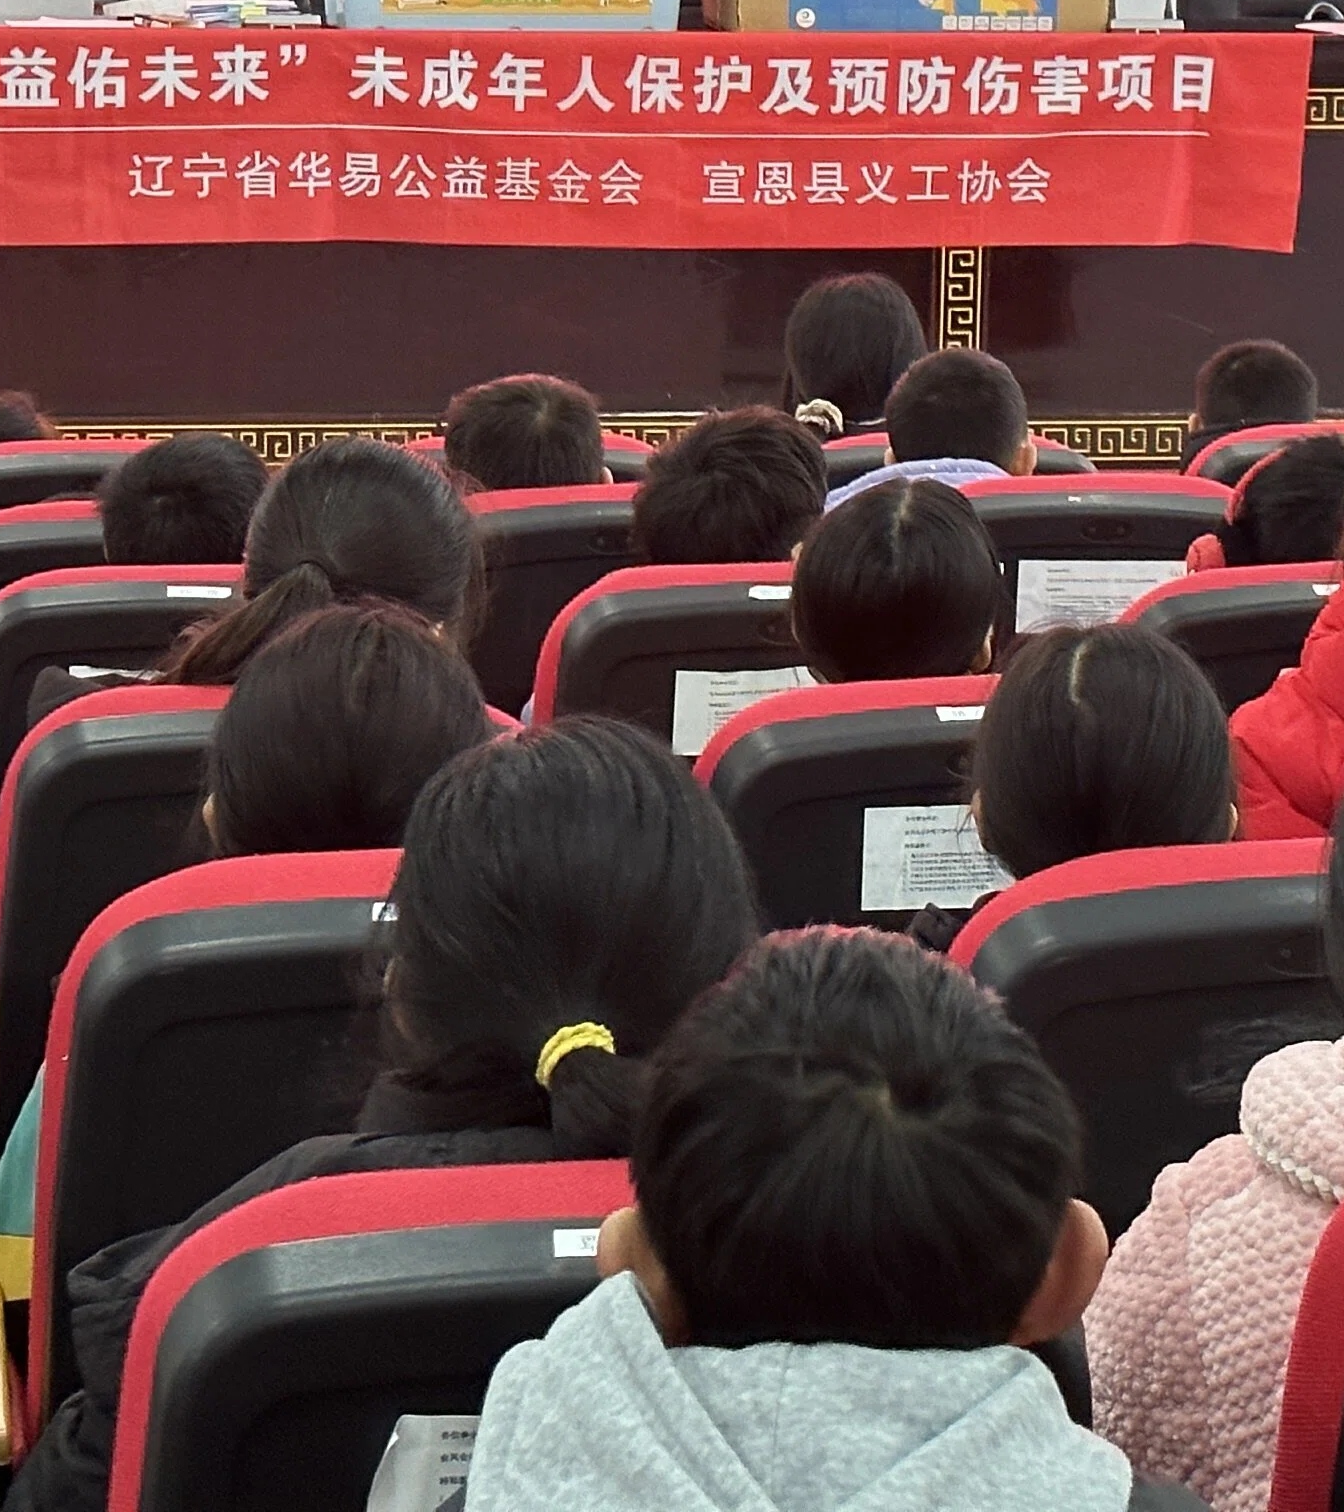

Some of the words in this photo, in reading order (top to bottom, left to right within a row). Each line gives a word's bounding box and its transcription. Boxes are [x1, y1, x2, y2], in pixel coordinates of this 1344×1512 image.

[349, 47, 1215, 115] 未成年人保护及预防伤害项目
[129, 150, 643, 204] 辽宁省华易公益基金会
[702, 158, 1052, 205] 宣恩县义工协会
